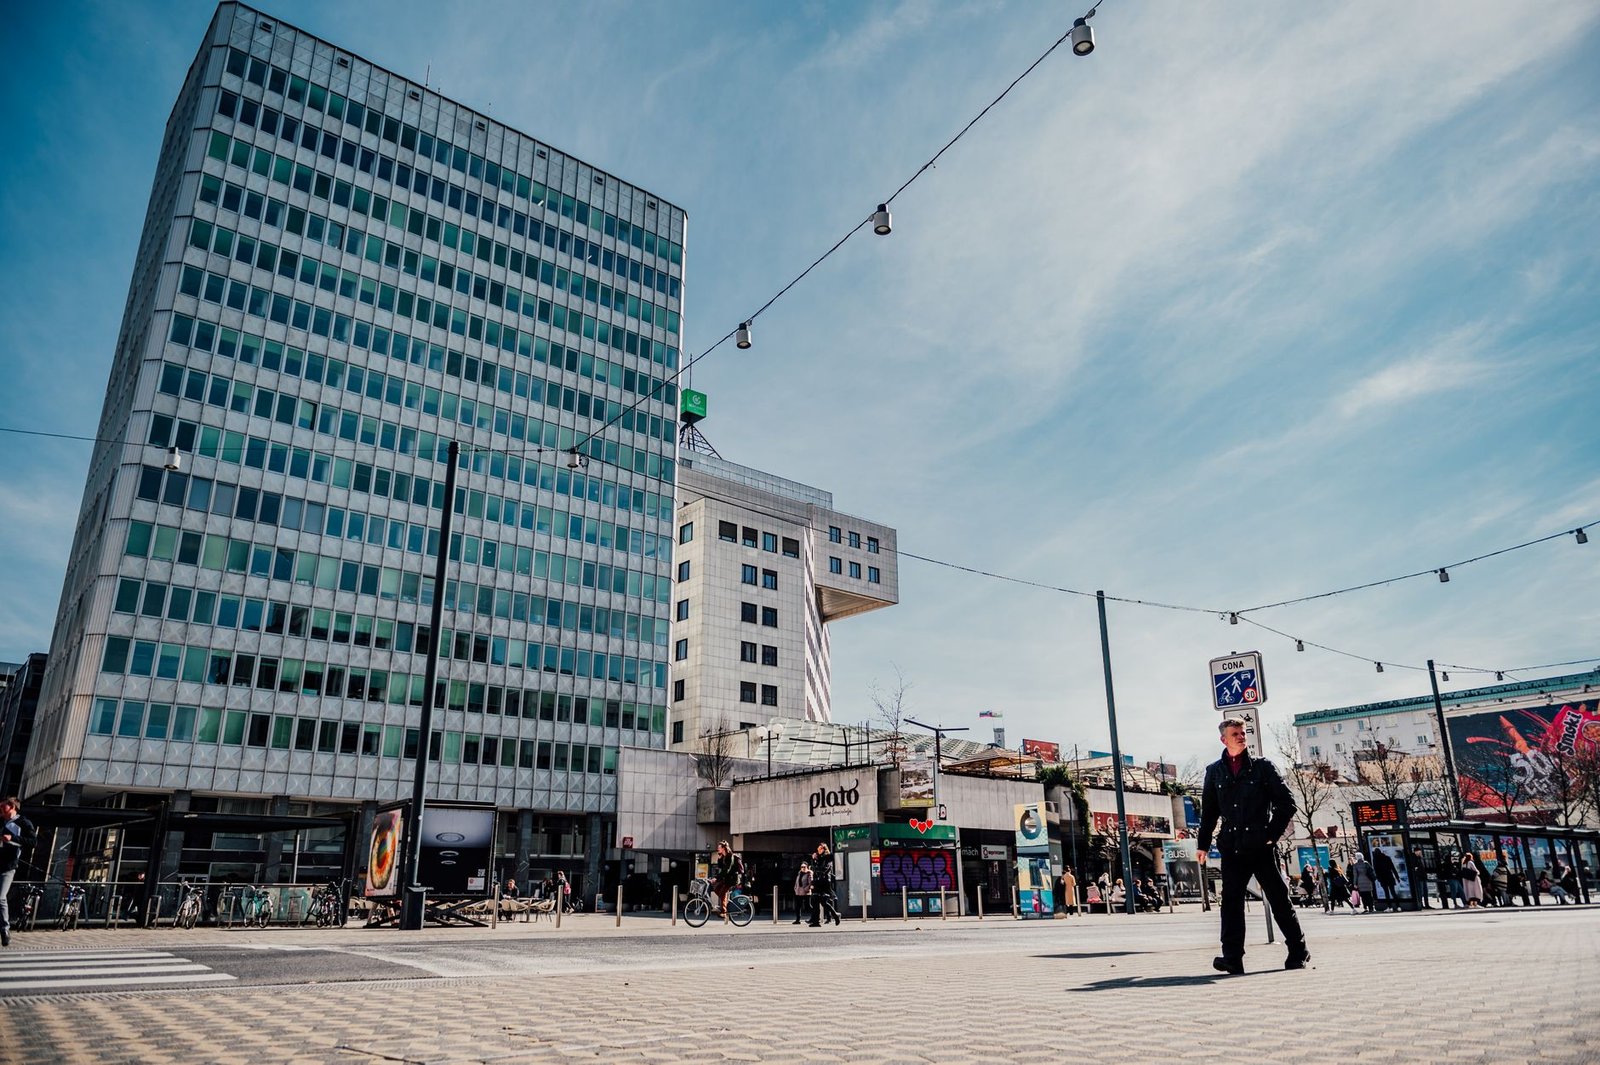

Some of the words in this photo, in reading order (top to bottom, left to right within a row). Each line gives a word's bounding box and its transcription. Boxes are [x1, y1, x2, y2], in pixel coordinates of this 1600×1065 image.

[1222, 660, 1244, 671] CONA
[1246, 690, 1255, 699] 30
[1556, 711, 1582, 757] Smoki
[1510, 749, 1554, 784] 50
[1164, 848, 1191, 859] Faust
